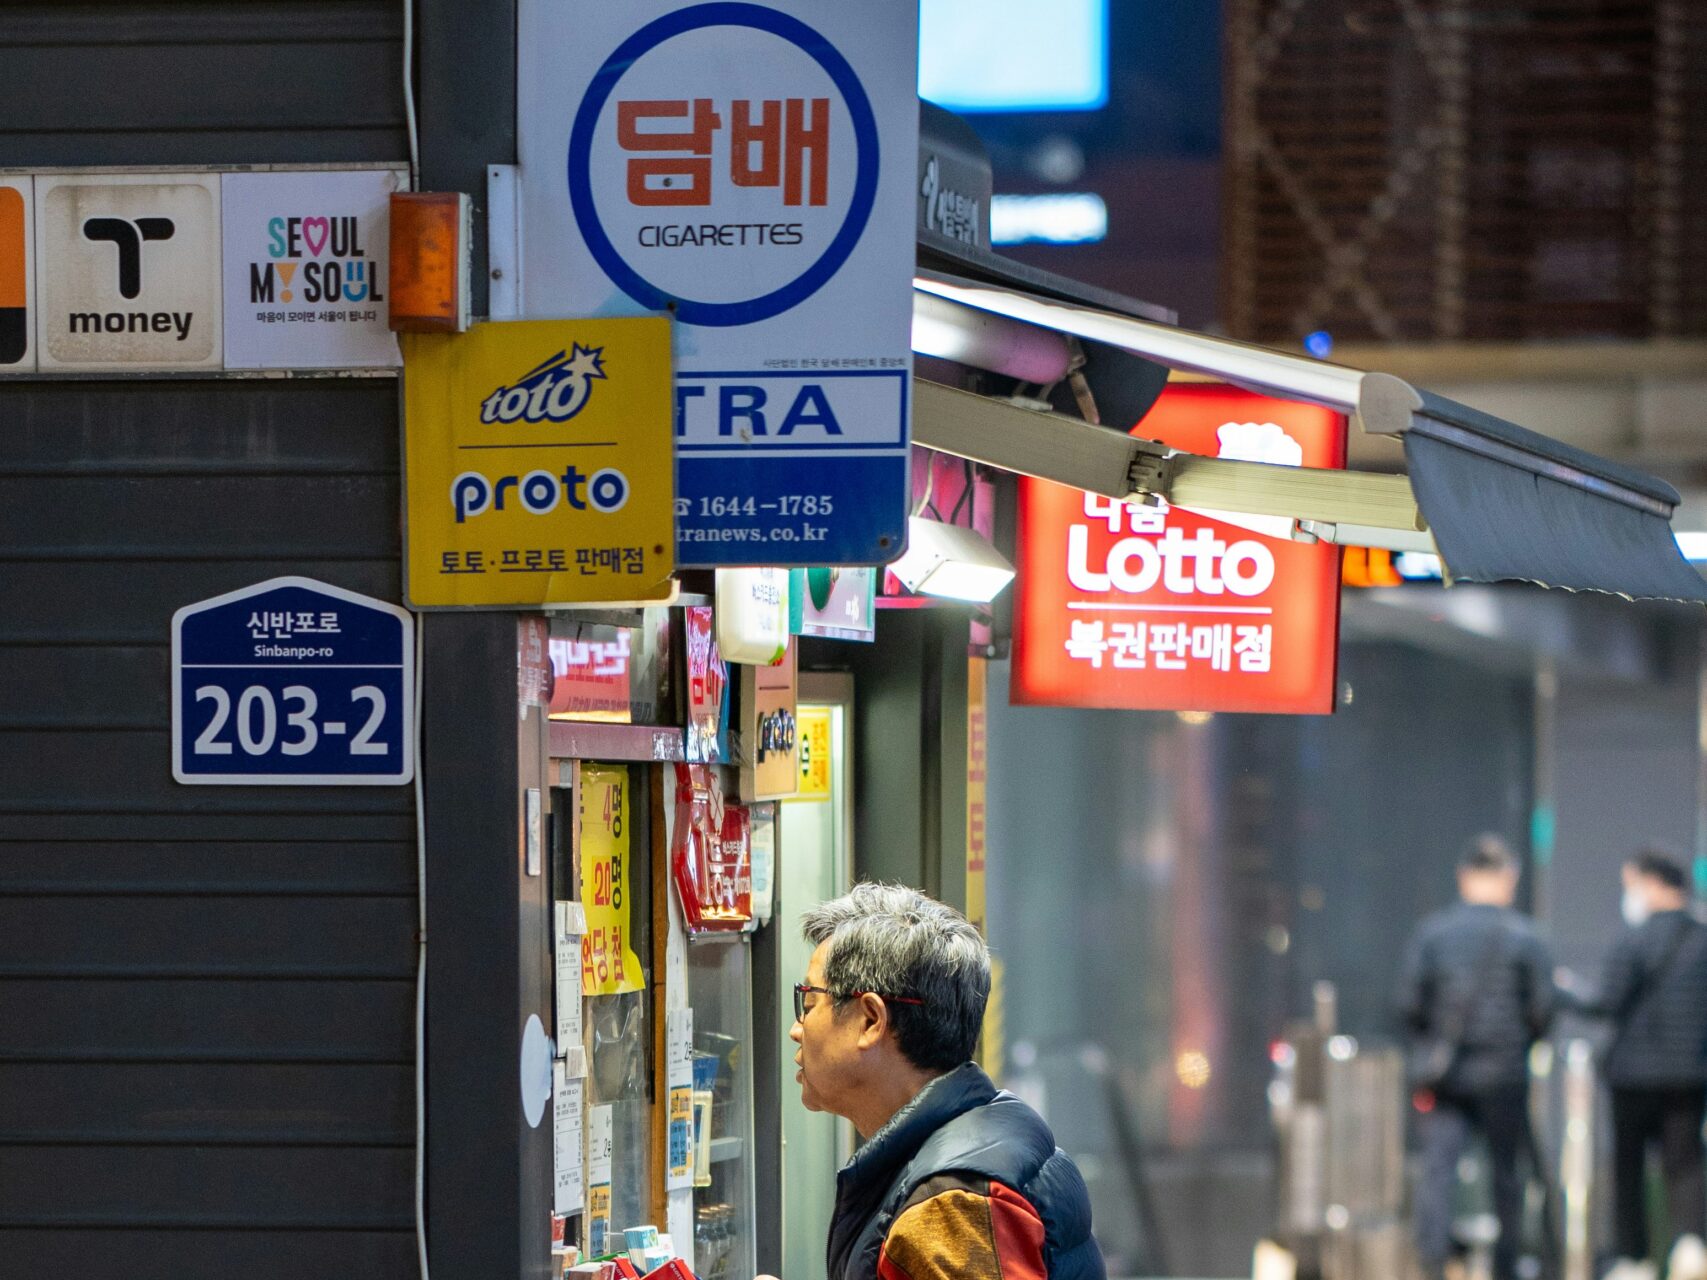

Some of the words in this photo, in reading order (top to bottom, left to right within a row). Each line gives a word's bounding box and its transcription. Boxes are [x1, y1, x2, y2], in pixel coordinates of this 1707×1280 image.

[617, 98, 829, 206] 담배
[638, 223, 803, 247] CIGARETTES
[69, 312, 192, 341] money
[256, 311, 286, 323] 마음이
[287, 311, 316, 323] 모이면
[318, 310, 346, 322] 서울이
[481, 366, 596, 424] toto
[451, 466, 630, 523] proto
[700, 495, 834, 517] 1644-1785
[575, 547, 644, 575] 판매점
[1067, 525, 1275, 596] Lotto
[247, 611, 341, 638] 신반포로
[254, 645, 333, 659] Sinbanpo-ro
[1065, 619, 1273, 672] 복권판매점
[194, 685, 388, 756] 203-2
